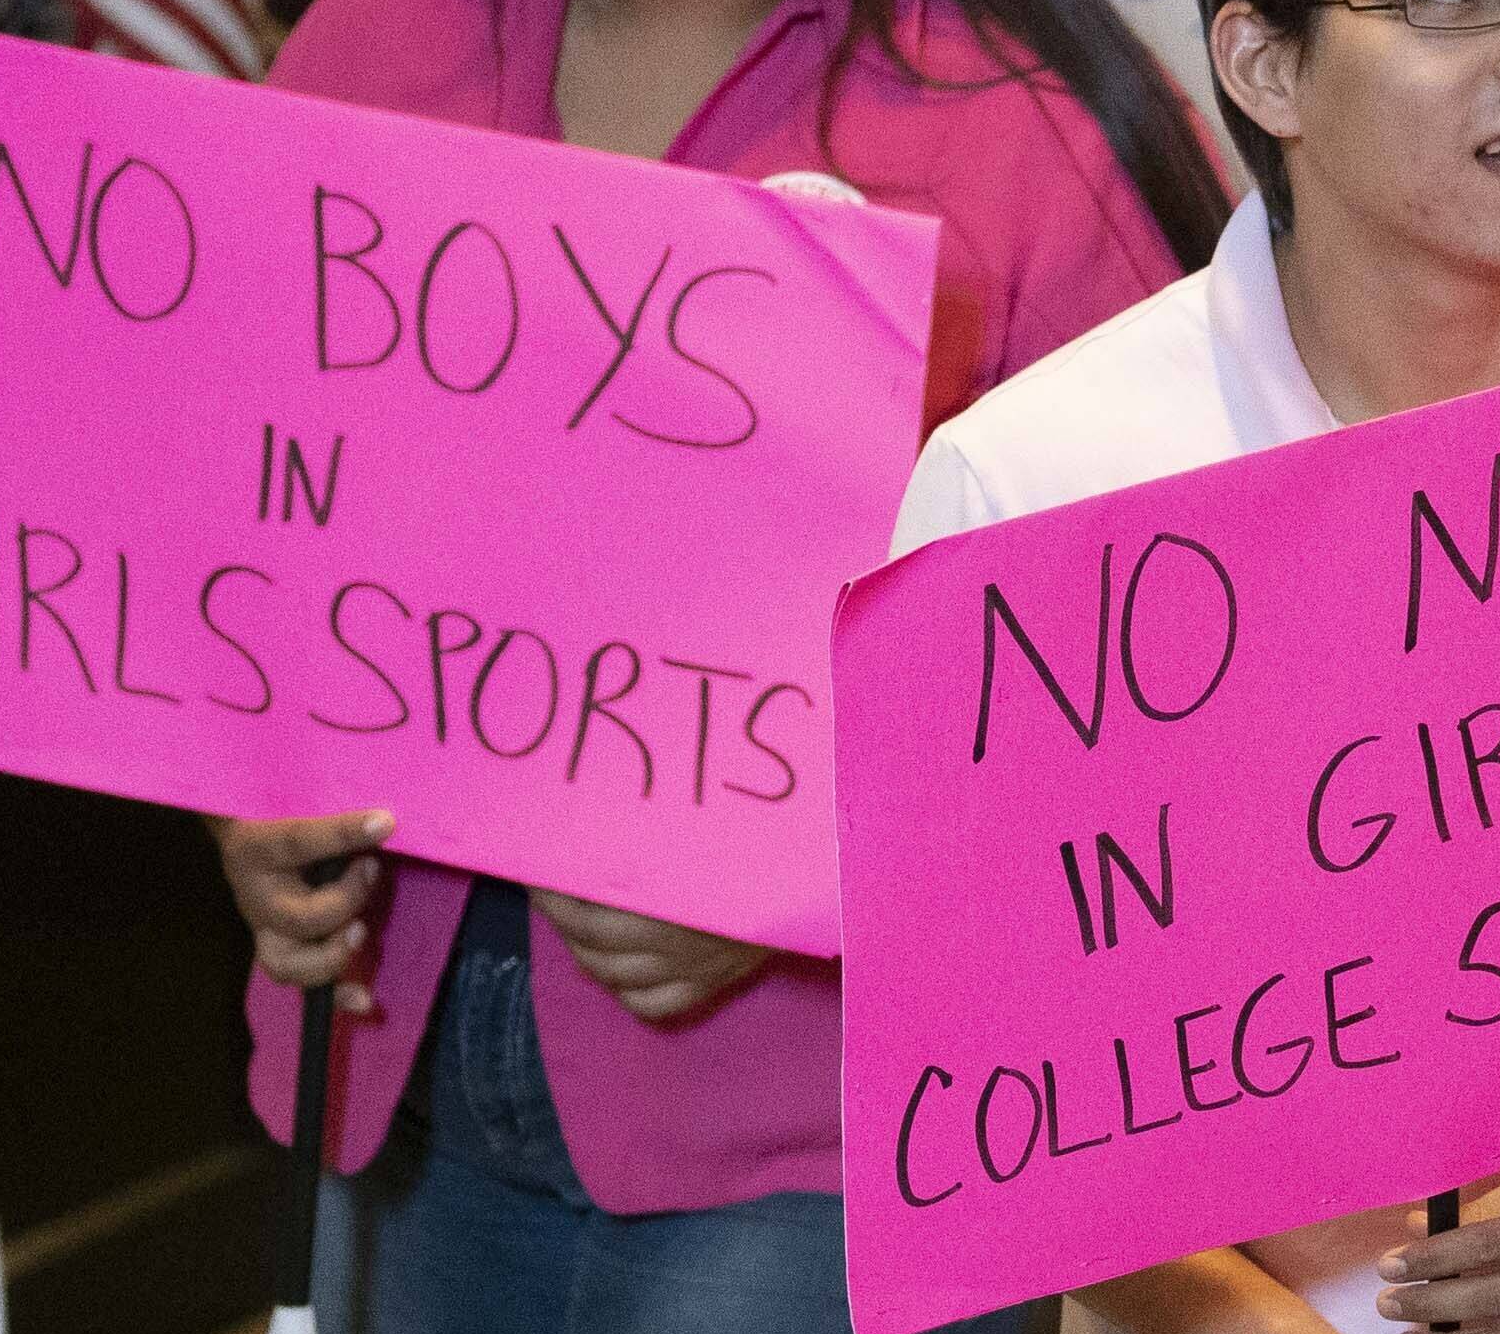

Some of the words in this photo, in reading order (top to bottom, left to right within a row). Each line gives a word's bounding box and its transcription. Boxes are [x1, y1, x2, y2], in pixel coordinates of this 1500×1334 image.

[311, 181, 780, 450] BOYS
[256, 422, 344, 527] IN
[306, 579, 814, 807] SPORTS
[971, 530, 1239, 765] NO
[1057, 801, 1175, 957] IN
[894, 954, 1402, 1209] COLLEGE
